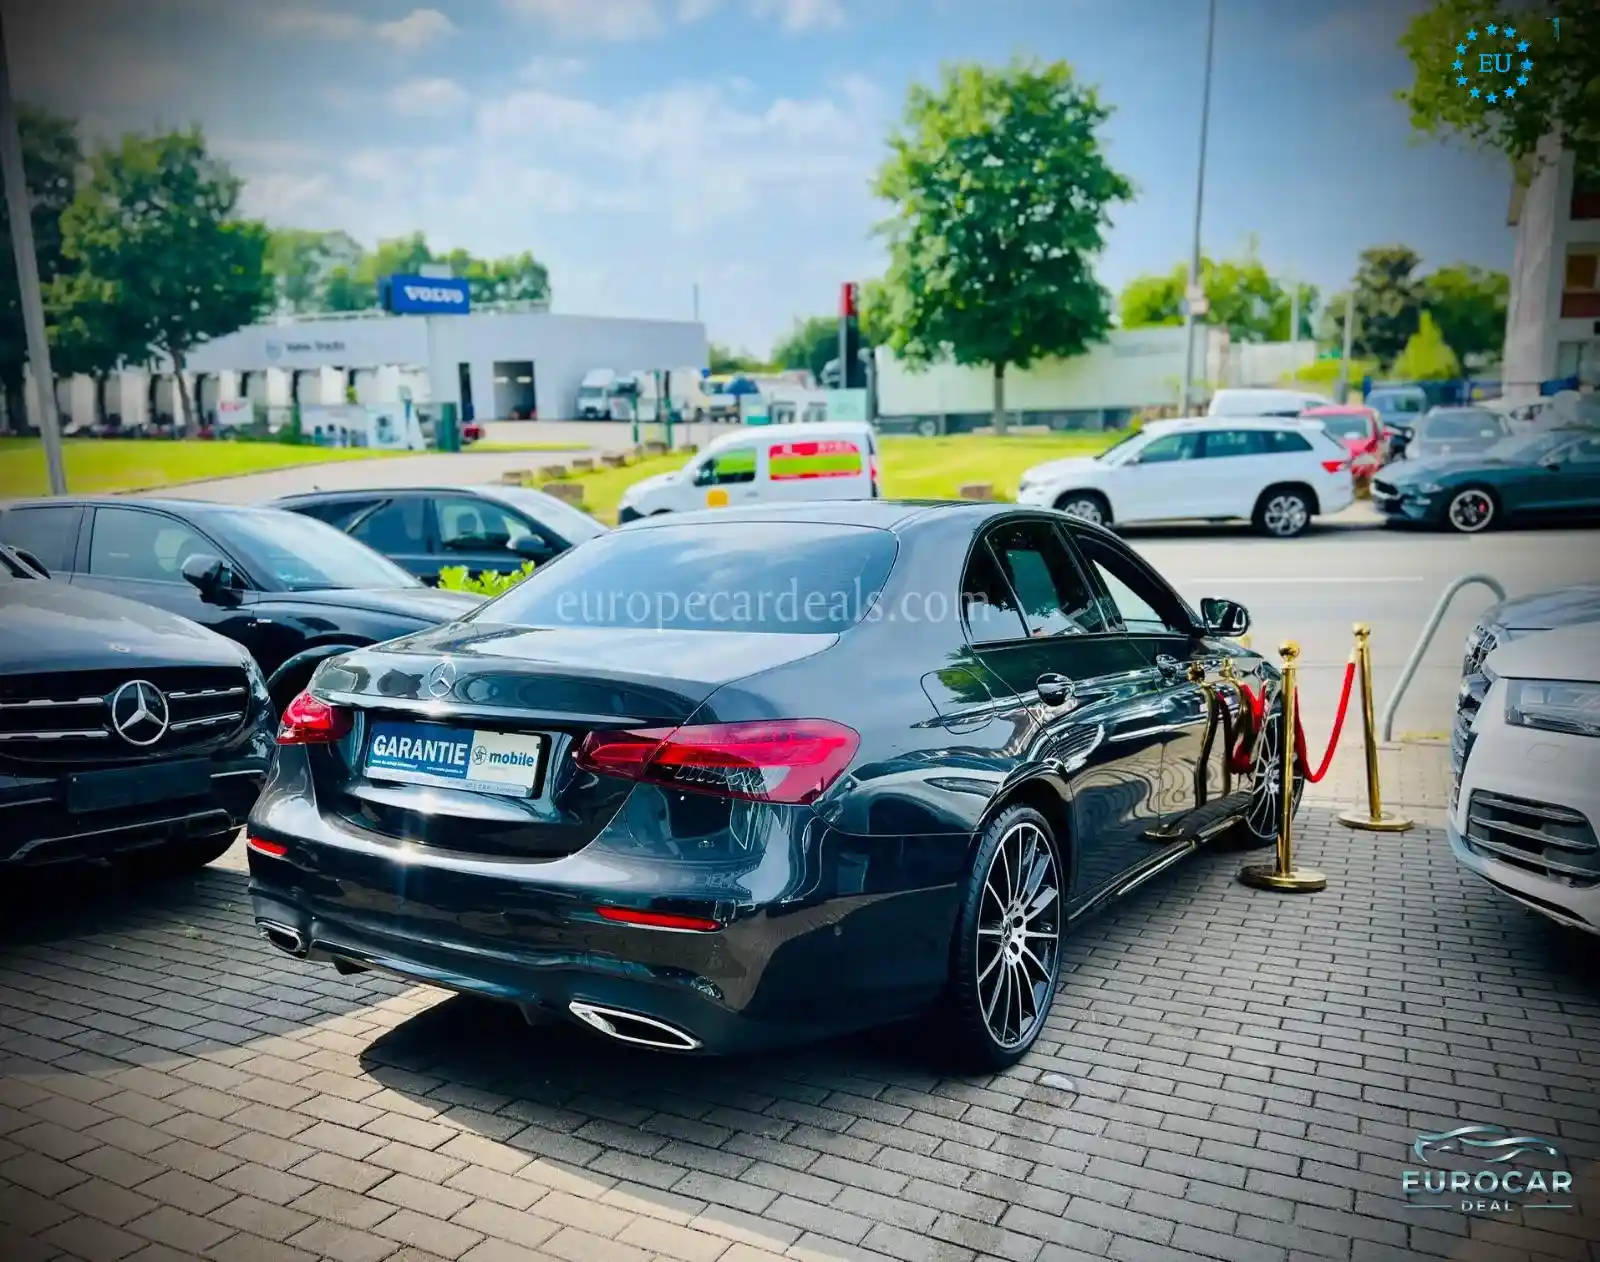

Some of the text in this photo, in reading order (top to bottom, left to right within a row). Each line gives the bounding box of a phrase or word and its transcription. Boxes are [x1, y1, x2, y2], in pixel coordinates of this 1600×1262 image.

[403, 285, 464, 304] VOLVO
[373, 734, 468, 766] GARANTIE
[488, 750, 535, 767] mobile
